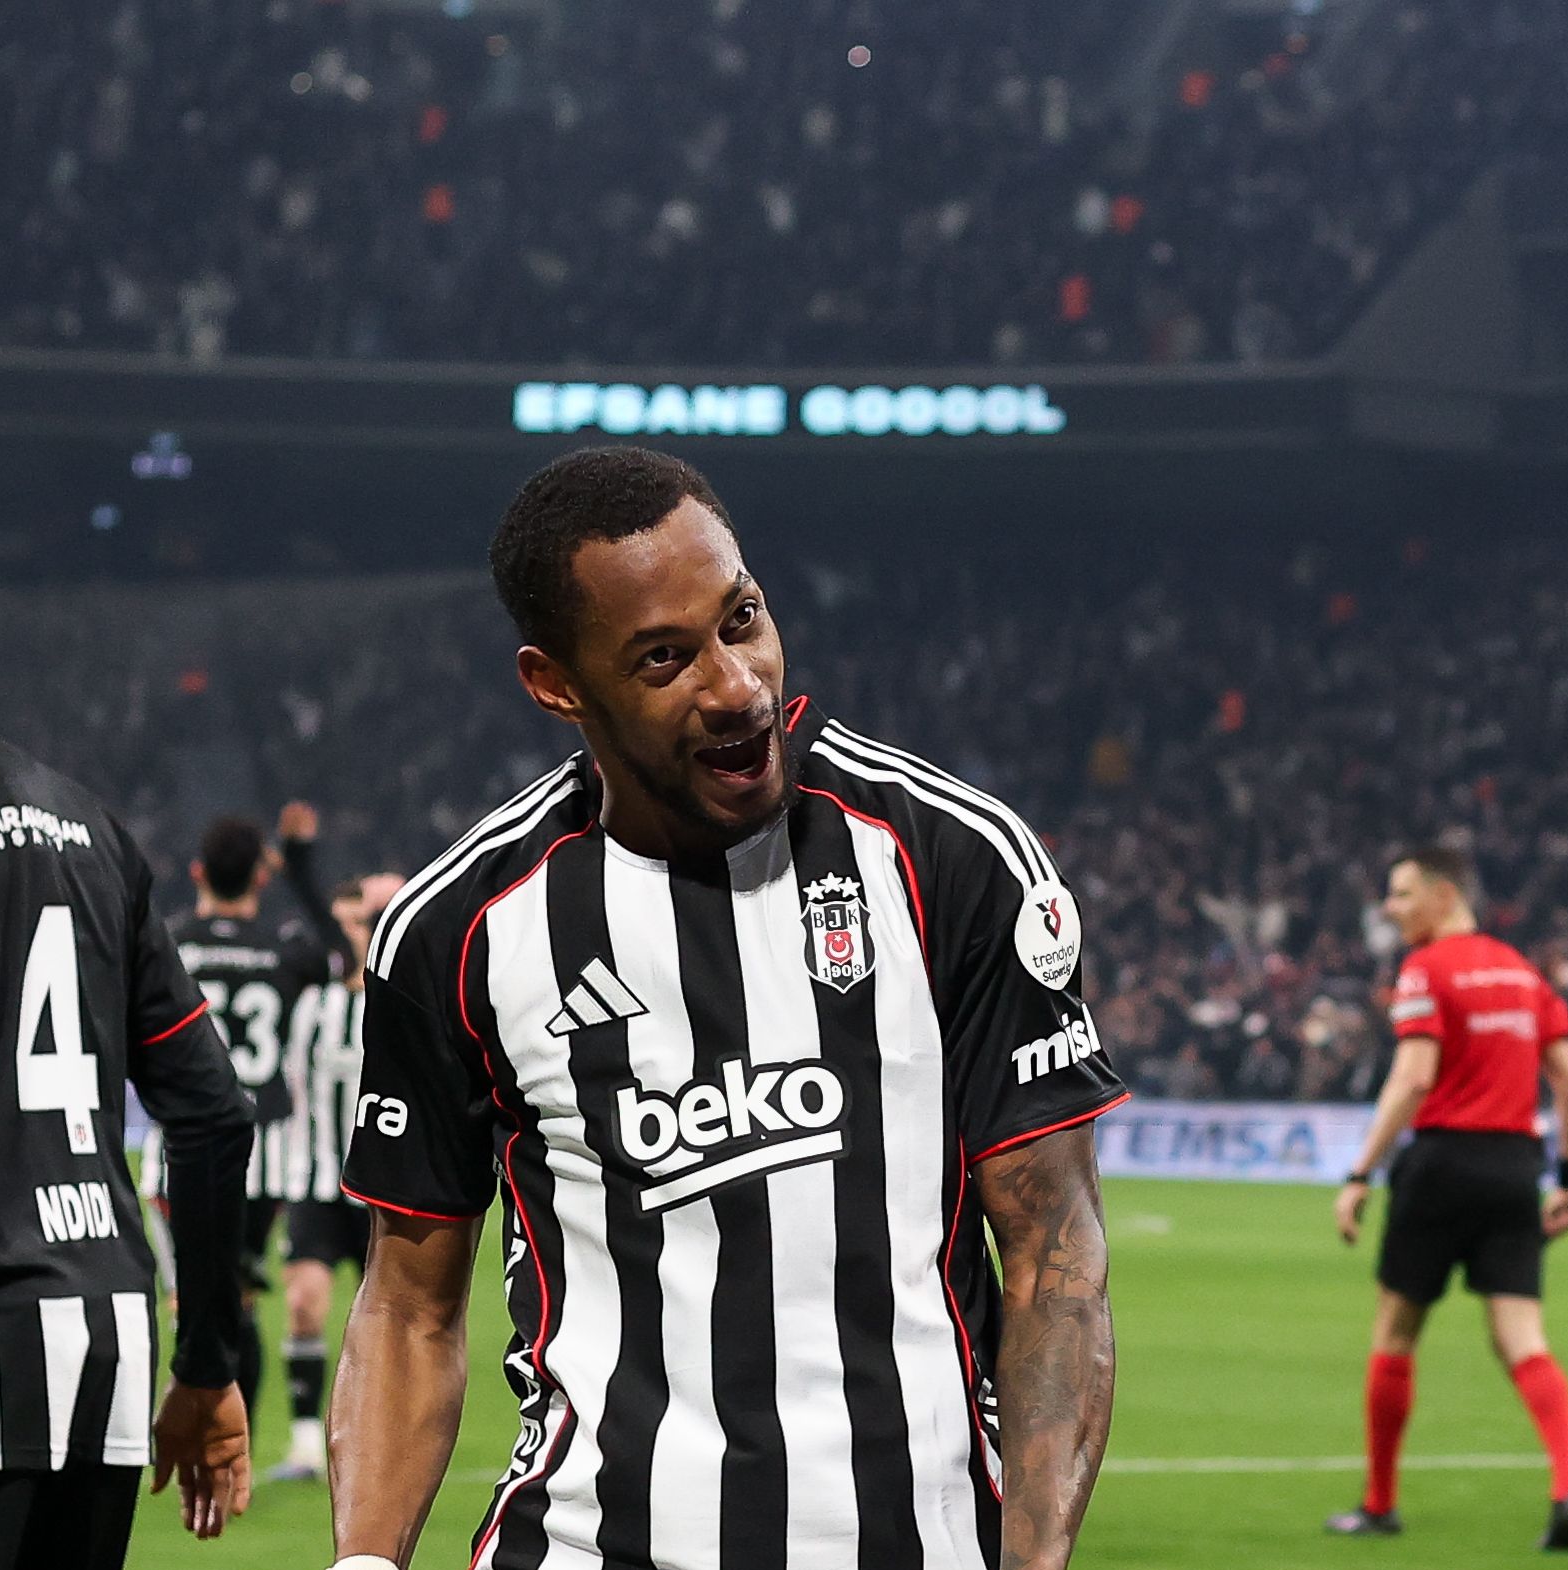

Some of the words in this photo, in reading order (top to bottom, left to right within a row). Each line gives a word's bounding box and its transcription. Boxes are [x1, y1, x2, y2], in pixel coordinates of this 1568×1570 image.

[812, 908, 860, 929] BJK
[822, 963, 864, 978] 1903
[1031, 941, 1076, 969] trendyol
[16, 904, 100, 1156] 4
[356, 1093, 409, 1137] ra
[616, 1060, 844, 1161] beko
[35, 1181, 119, 1243] NDIDI
